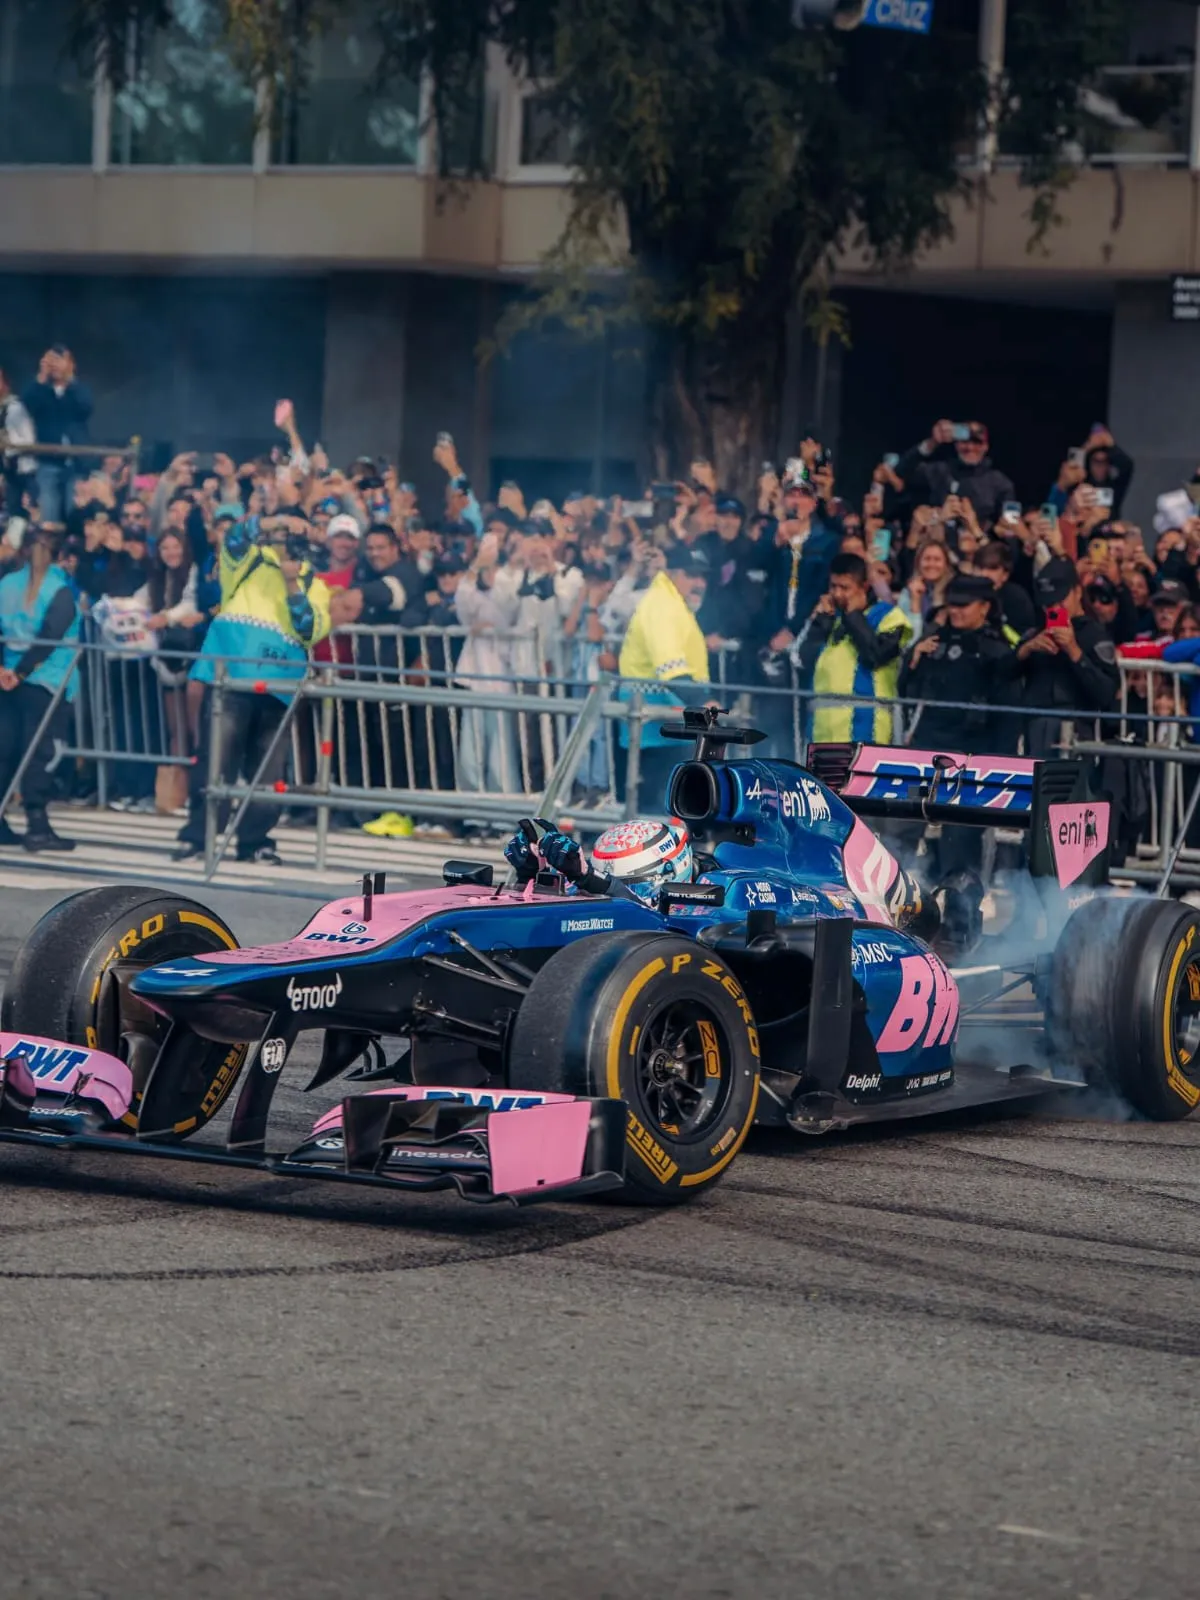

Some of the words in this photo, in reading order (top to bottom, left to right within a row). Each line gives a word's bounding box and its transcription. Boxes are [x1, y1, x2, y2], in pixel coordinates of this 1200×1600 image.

[782, 781, 806, 817] eni
[1058, 813, 1083, 846] eni
[303, 933, 376, 945] BWT
[863, 942, 894, 965] MSC
[671, 953, 692, 974] P
[701, 958, 761, 1058] ZERO
[846, 1074, 881, 1091] Delphi
[626, 1110, 679, 1185] PIRELL
